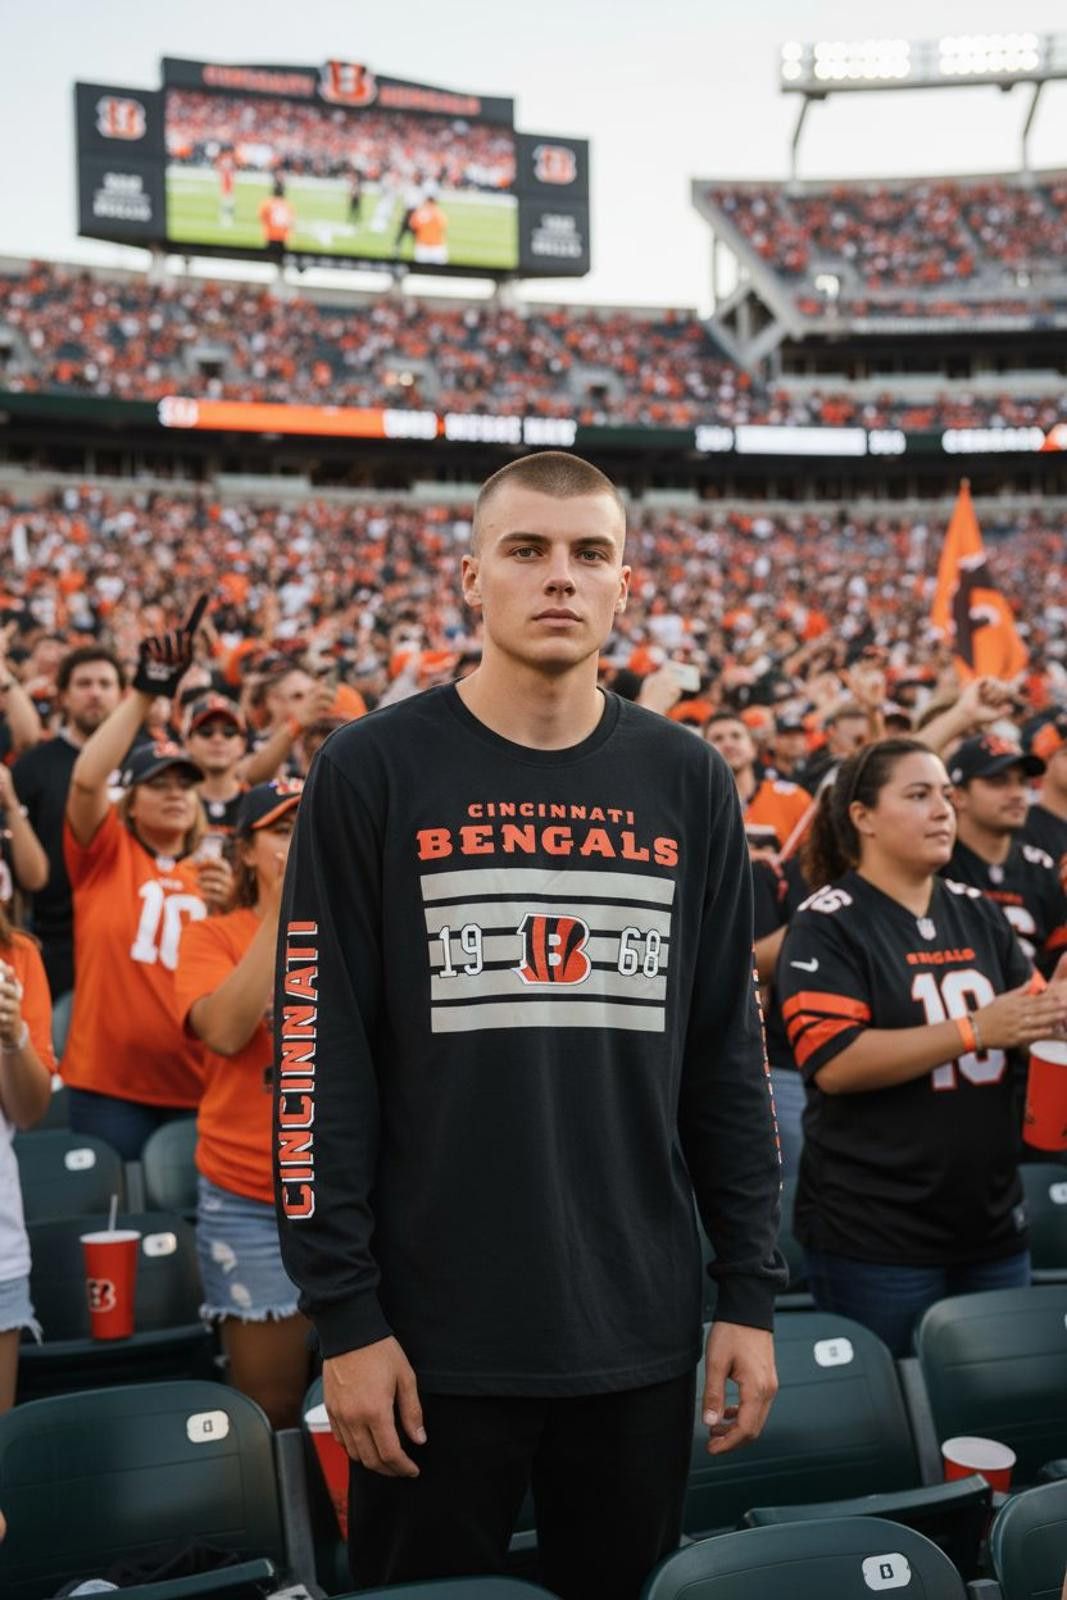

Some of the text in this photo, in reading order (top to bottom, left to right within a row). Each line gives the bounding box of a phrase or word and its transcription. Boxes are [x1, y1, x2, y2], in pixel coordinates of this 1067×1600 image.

[467, 802, 635, 825] CINCINNATI
[416, 824, 679, 868] BENGALS
[438, 912, 661, 985] 19 B 68
[278, 921, 318, 1220] CINCINNATI
